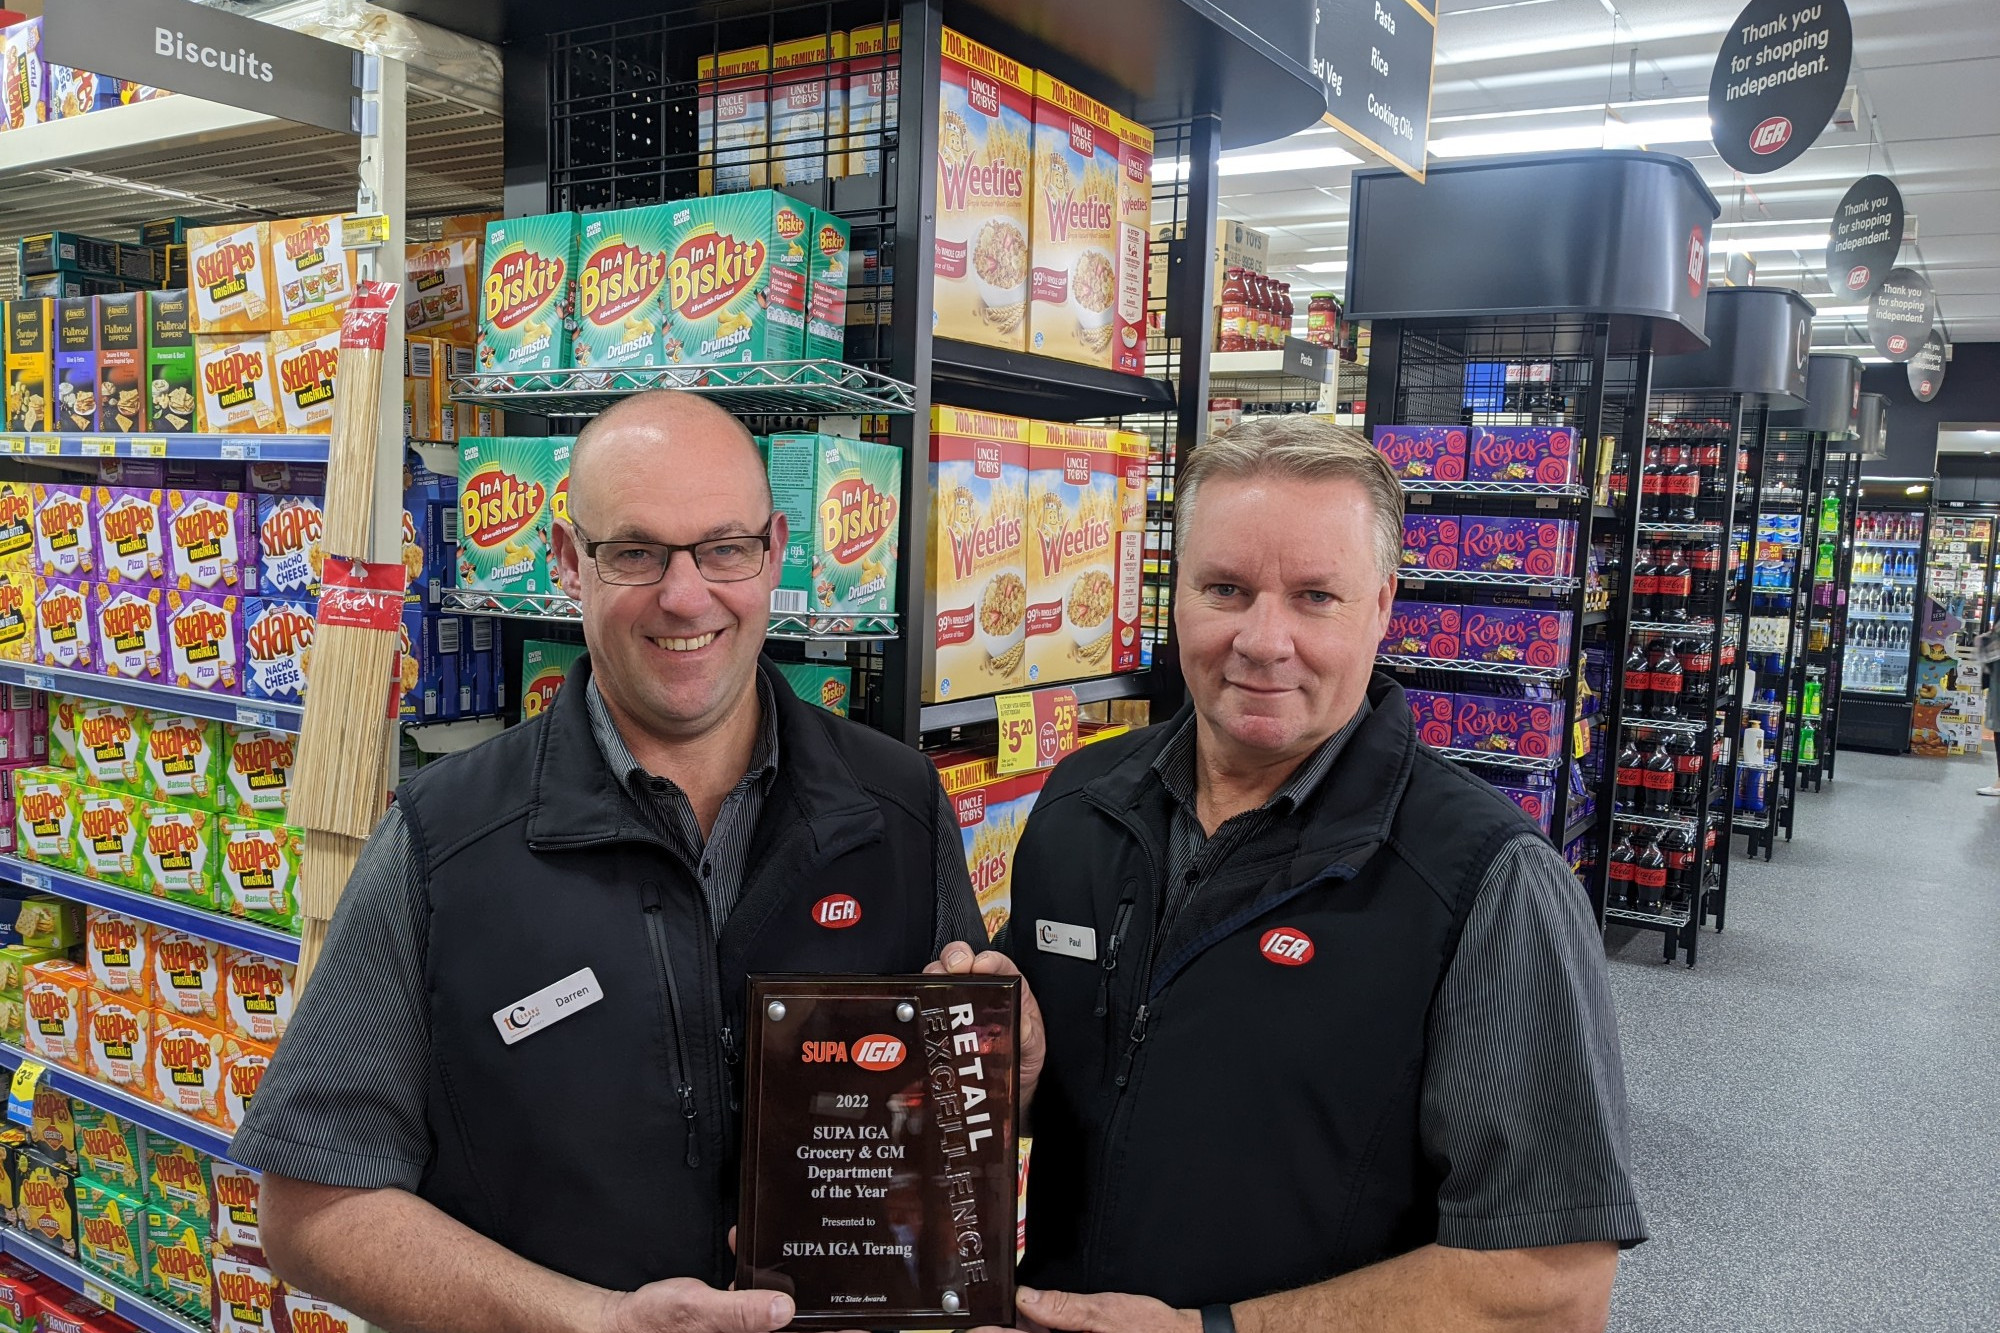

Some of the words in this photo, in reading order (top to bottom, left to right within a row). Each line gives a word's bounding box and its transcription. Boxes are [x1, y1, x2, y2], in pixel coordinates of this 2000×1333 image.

[1374, 1, 1395, 36] Pasta
[1742, 14, 1787, 46] Thank
[1792, 4, 1822, 31] you
[155, 27, 273, 83] Biscuits
[944, 31, 966, 59] 700g
[967, 41, 996, 74] FAMILY
[998, 53, 1020, 84] PACK
[1371, 47, 1388, 77] Rice
[1731, 55, 1752, 75] for
[1755, 28, 1829, 66] shopping
[971, 77, 997, 99] UNCLE
[1326, 61, 1342, 97] Veg
[1726, 55, 1829, 102] independent.
[718, 94, 743, 107] UNCLE
[971, 92, 997, 112] TOBYS
[1069, 88, 1092, 119] FAMILY
[1094, 102, 1110, 128] PACK
[1368, 93, 1398, 136] Cooking
[1399, 116, 1413, 141] Oils
[1071, 123, 1092, 141] UNCLE
[1753, 120, 1784, 149] IGA
[938, 150, 1023, 211] Weeties
[673, 208, 690, 221] OVEN
[1045, 186, 1112, 242] Weeties
[1121, 196, 1148, 215] Weeties
[1844, 199, 1869, 216] Thank
[1871, 197, 1888, 210] you
[1838, 223, 1850, 236] for
[1851, 211, 1891, 232] shopping
[1246, 231, 1262, 249] TOYS
[1835, 230, 1891, 253] independent.
[298, 254, 324, 269] ORIGINALS
[601, 256, 612, 274] In
[614, 251, 623, 268] A
[690, 247, 704, 265] In
[705, 241, 715, 256] A
[1688, 236, 1703, 284] IGA
[504, 261, 515, 278] In
[516, 257, 524, 272] A
[668, 242, 757, 311] Biskit
[1848, 268, 1867, 286] IGA
[213, 282, 246, 300] ORIGINALS
[484, 257, 558, 321] Biskit
[580, 250, 661, 317] Biskit
[1883, 284, 1906, 296] Thank
[1907, 288, 1922, 297] you
[1878, 296, 1890, 307] for
[1890, 299, 1925, 312] shopping
[1875, 309, 1925, 324] independent.
[508, 335, 550, 362] Drumstix
[607, 331, 653, 361] Drumstix
[701, 326, 750, 356] Drumstix
[1889, 338, 1905, 350] IGA
[1300, 353, 1314, 367] Pasta
[955, 412, 973, 434] 700g
[974, 414, 999, 436] FAMILY
[1000, 418, 1018, 439] PACK
[1045, 425, 1063, 445] 700g
[1064, 427, 1088, 447] FAMILY
[1089, 431, 1108, 449] PACK
[977, 447, 999, 461] UNCLE
[1377, 432, 1444, 467] Roses
[1471, 433, 1546, 467] Roses
[977, 460, 999, 474] TOBYS
[1067, 457, 1088, 469] UNCLE
[1067, 467, 1088, 480] TOBYS
[480, 481, 491, 497] In
[493, 477, 501, 492] A
[842, 490, 852, 507] In
[854, 486, 862, 502] A
[460, 479, 538, 536] Biskit
[820, 489, 891, 552] Biskit
[53, 534, 78, 548] ORIGINALS
[947, 514, 1021, 581] Weeties
[1036, 515, 1110, 578] Weeties
[1459, 524, 1535, 557] Roses
[127, 559, 144, 571] Pizza
[198, 565, 217, 578] Pizza
[277, 553, 303, 572] NACHO
[491, 557, 534, 580] Drumstix
[276, 563, 309, 586] CHEESE
[848, 573, 887, 600] Drumstix
[938, 615, 952, 632] 99%
[1462, 614, 1537, 647] Roses
[60, 646, 74, 657] Pizza
[125, 656, 141, 668] Pizza
[197, 666, 214, 678] Pizza
[265, 659, 294, 677] NACHO
[264, 669, 300, 690] CHEESE
[1054, 705, 1077, 731] 25%
[1454, 703, 1528, 736] Roses
[1060, 731, 1073, 751] off
[251, 774, 284, 787] ORIGINALS
[959, 795, 982, 811] UNCLE
[243, 873, 272, 886] ORIGINALS
[820, 900, 857, 923] IGA
[1069, 937, 1082, 948] Paul
[1263, 933, 1310, 960] IGA
[246, 999, 275, 1011] ORIGINALS
[555, 986, 590, 1007] Darren
[802, 1041, 848, 1063] SUPA
[857, 1041, 901, 1062] IGA
[948, 1002, 993, 1152] RETAIL
[836, 1094, 868, 1108] 2022
[813, 1126, 854, 1140] SUPA
[858, 1126, 889, 1140] IGA
[796, 1146, 854, 1162] Grocery
[859, 1146, 872, 1159] &
[876, 1145, 905, 1159] GM
[808, 1165, 892, 1181] Department
[811, 1185, 826, 1198] of
[829, 1185, 851, 1198] the
[855, 1185, 888, 1198] Year
[822, 1217, 863, 1227] Presented
[866, 1218, 876, 1227] to
[783, 1243, 824, 1257] SUPA
[828, 1243, 859, 1256] IGA
[863, 1242, 912, 1258] Terang
[830, 1295, 845, 1303] VIC
[845, 1295, 862, 1303] State
[862, 1294, 887, 1303] Awards
[234, 1307, 262, 1322] ORIGINALS
